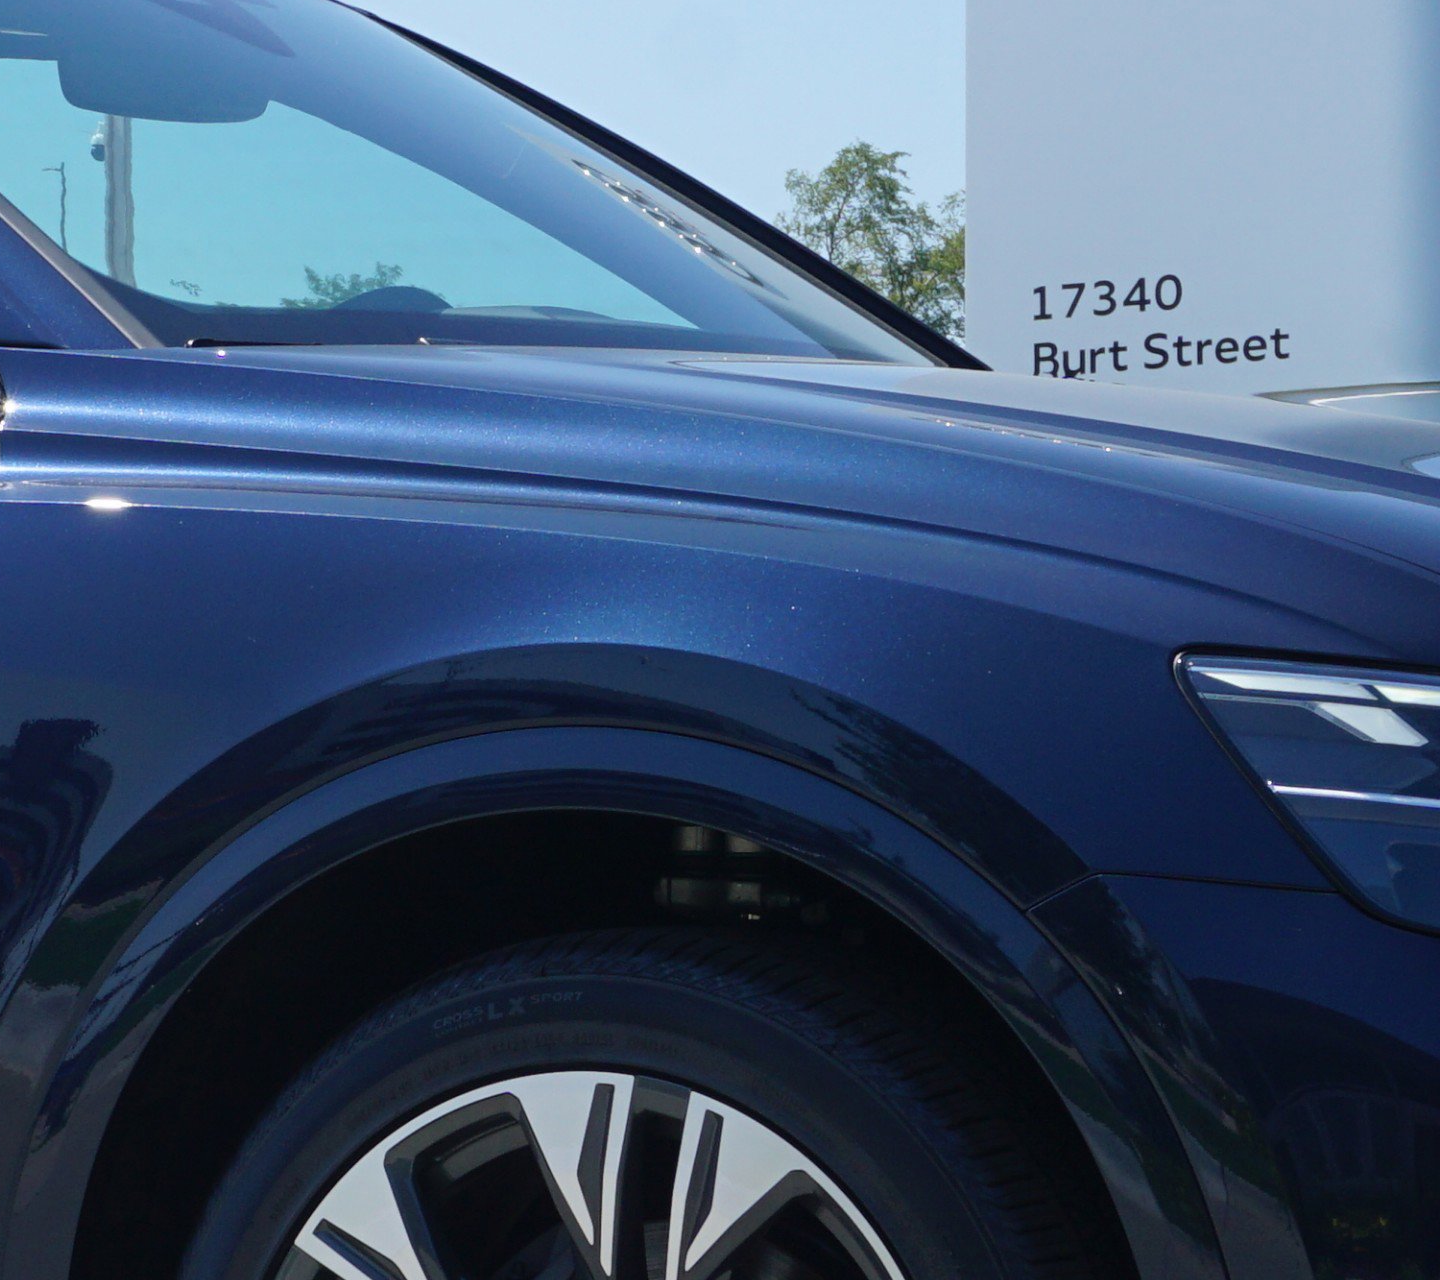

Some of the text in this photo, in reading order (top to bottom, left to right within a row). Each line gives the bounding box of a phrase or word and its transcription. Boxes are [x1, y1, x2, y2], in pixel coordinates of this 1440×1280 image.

[1032, 274, 1183, 321] 17340
[1033, 328, 1291, 378] Burt Street
